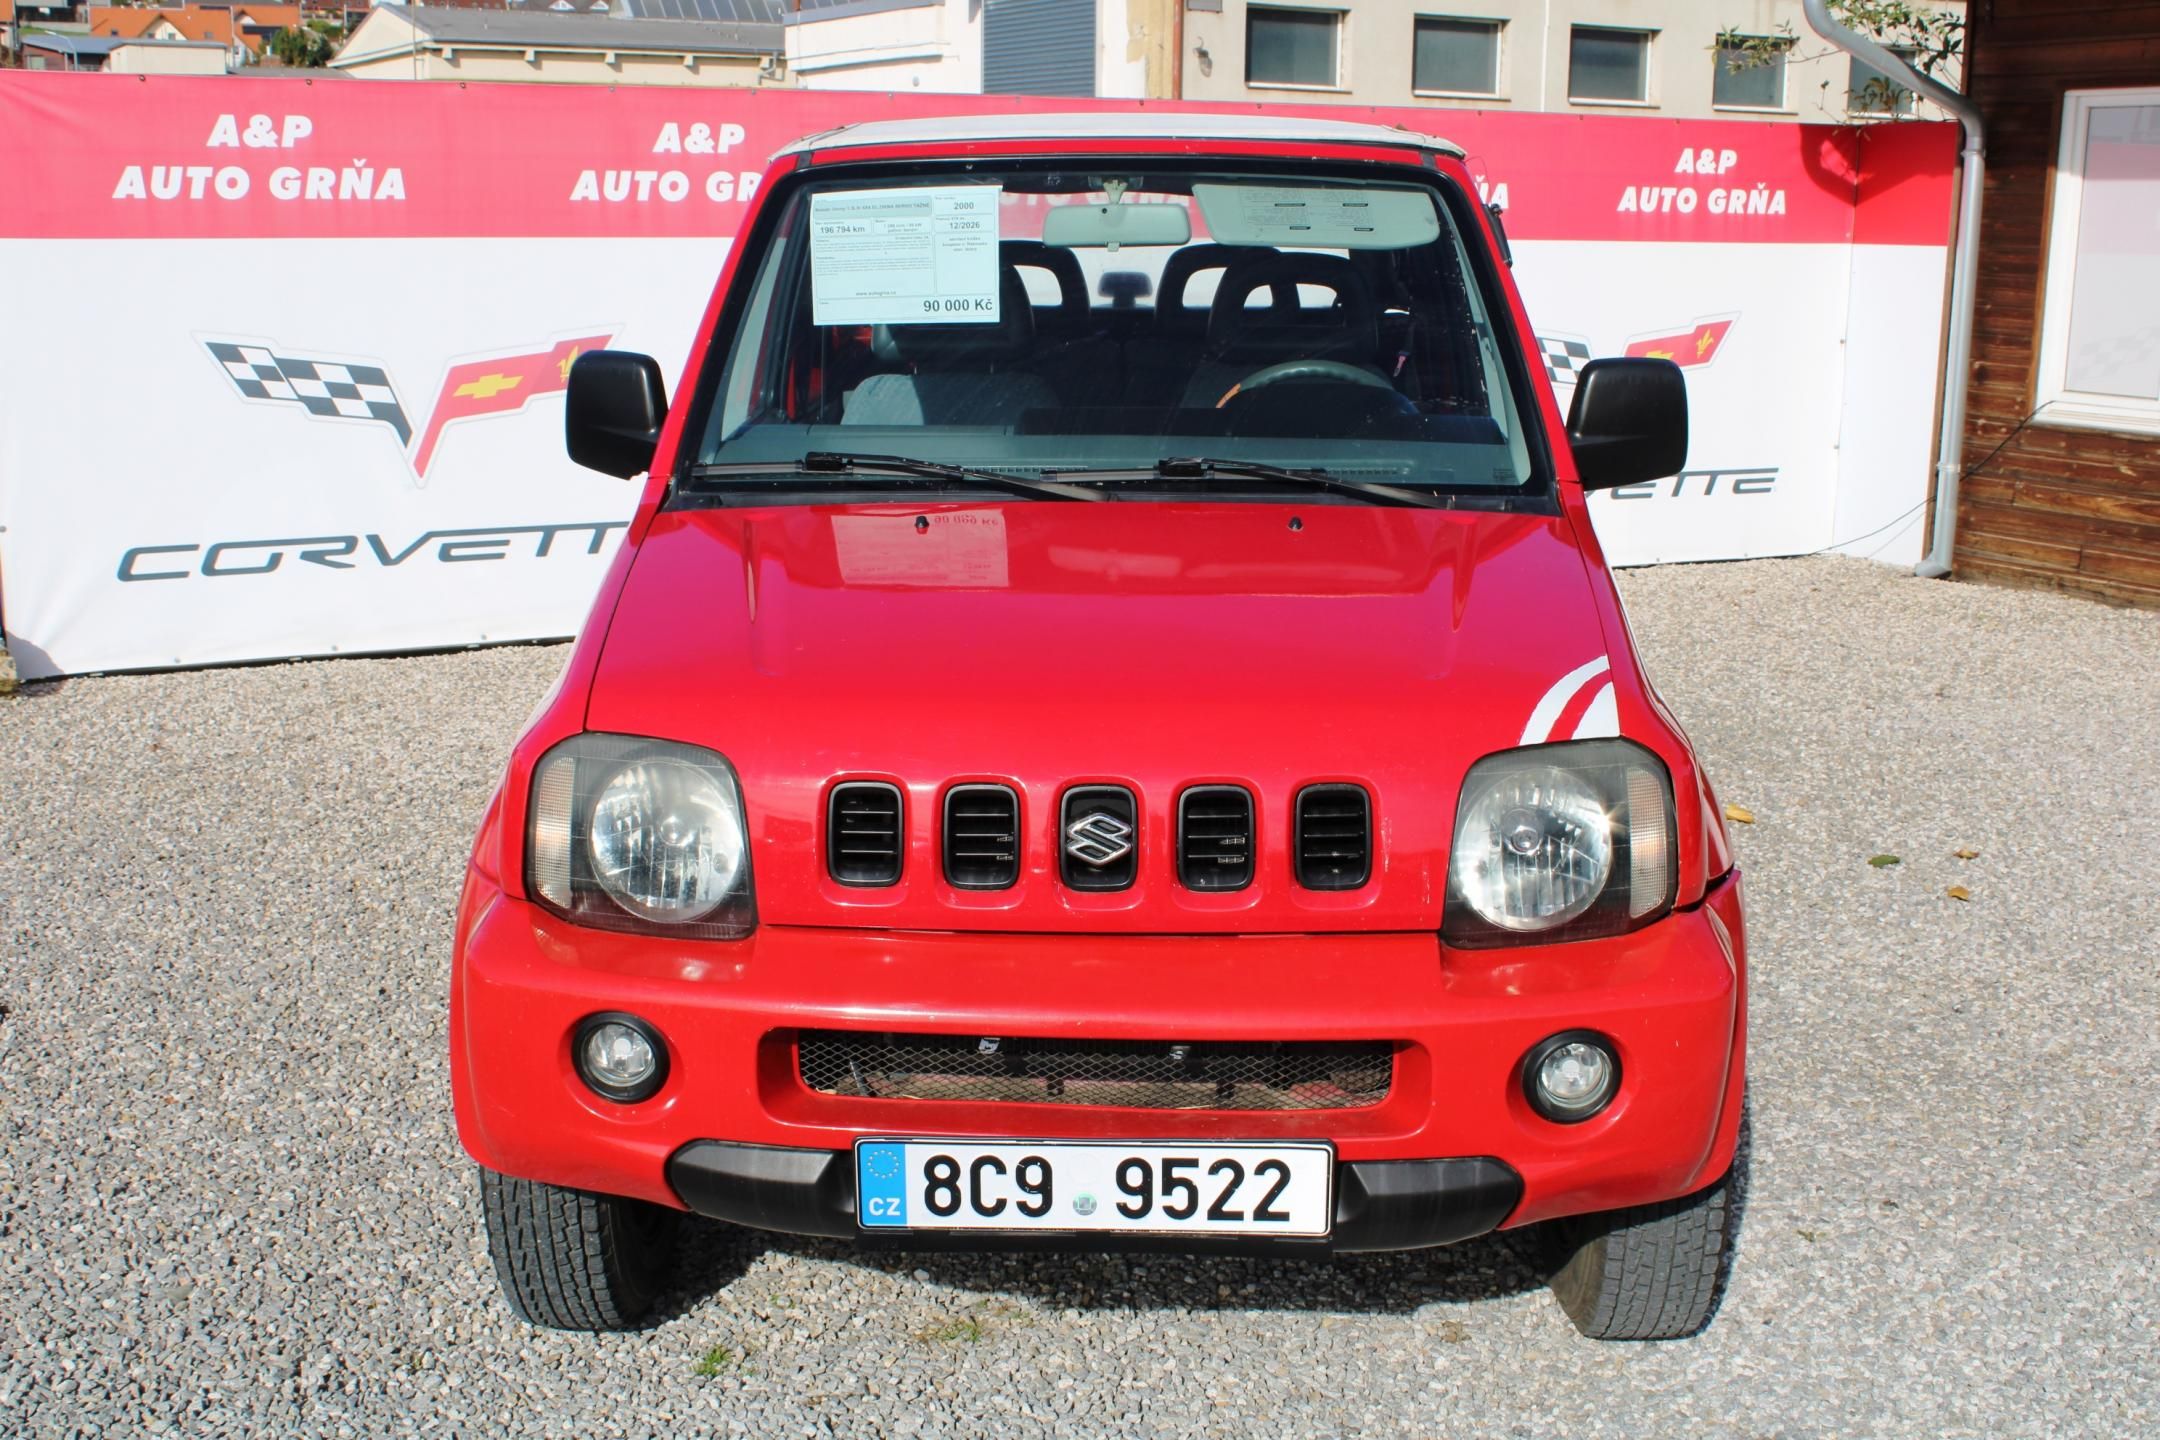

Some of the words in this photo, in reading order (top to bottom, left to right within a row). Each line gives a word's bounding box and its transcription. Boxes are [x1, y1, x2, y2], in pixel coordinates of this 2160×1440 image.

[206, 113, 312, 148] A&P
[652, 122, 745, 154] A&P
[1675, 148, 1738, 175] A&P
[111, 165, 251, 201] AUTO
[269, 158, 406, 201] GRŇA
[569, 170, 690, 202] AUTO
[705, 171, 763, 202] GR
[953, 202, 975, 210] 2000
[1617, 186, 1697, 213] AUTO
[1707, 182, 1786, 215] GRŇA
[820, 225, 834, 234] 196
[837, 225, 851, 233] 794
[949, 221, 981, 230] 12/2026
[923, 300, 940, 312] 90
[944, 300, 970, 312] 000
[974, 299, 993, 311] Kč
[117, 521, 630, 582] CORVETT
[868, 1197, 901, 1216] CZ
[923, 1154, 1053, 1218] 8C9
[1115, 1156, 1291, 1222] 9522
